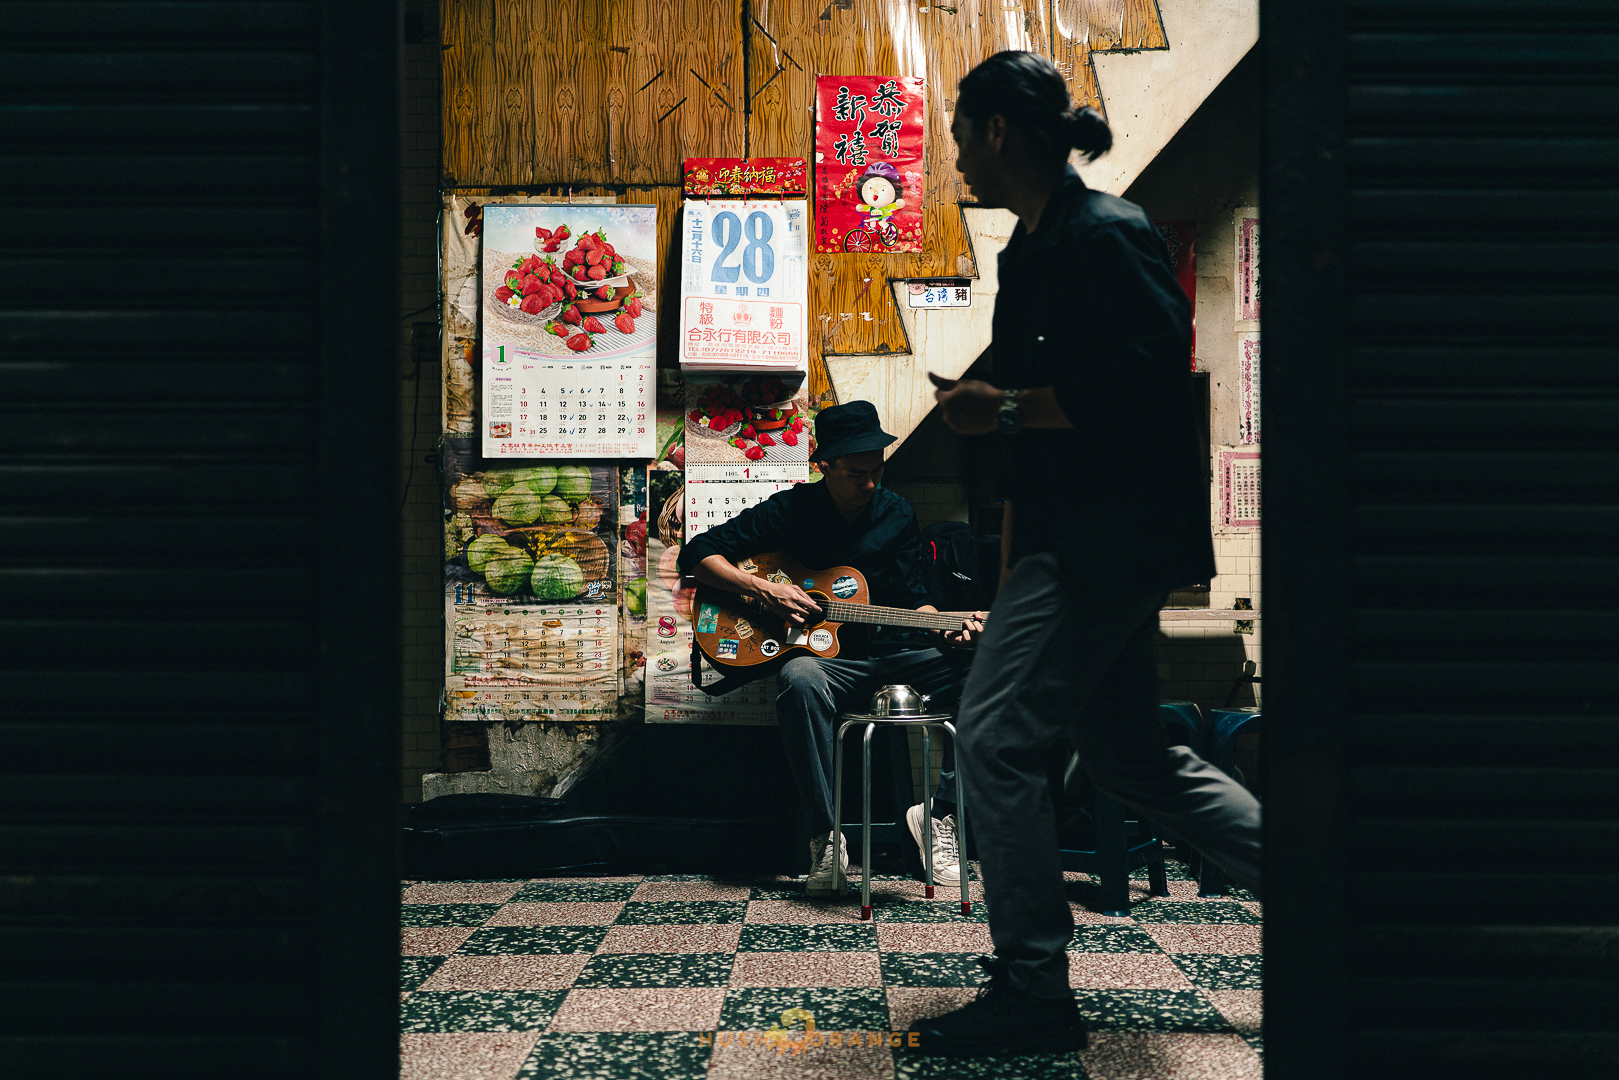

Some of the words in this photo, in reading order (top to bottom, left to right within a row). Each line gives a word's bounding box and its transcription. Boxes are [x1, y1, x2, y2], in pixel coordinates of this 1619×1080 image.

[831, 86, 868, 166] 新禧
[869, 80, 908, 159] 恭賀
[714, 165, 777, 186] 迎春納福
[691, 218, 703, 263] 十二月十六日
[711, 211, 775, 284] 28
[714, 285, 770, 297] 星期四
[955, 288, 967, 301] 豬
[699, 302, 714, 325] 特級
[688, 327, 791, 345] 合永行有限公司
[496, 345, 508, 363] 1
[744, 468, 750, 478] 1
[454, 582, 477, 605] 11
[658, 616, 678, 638] 8
